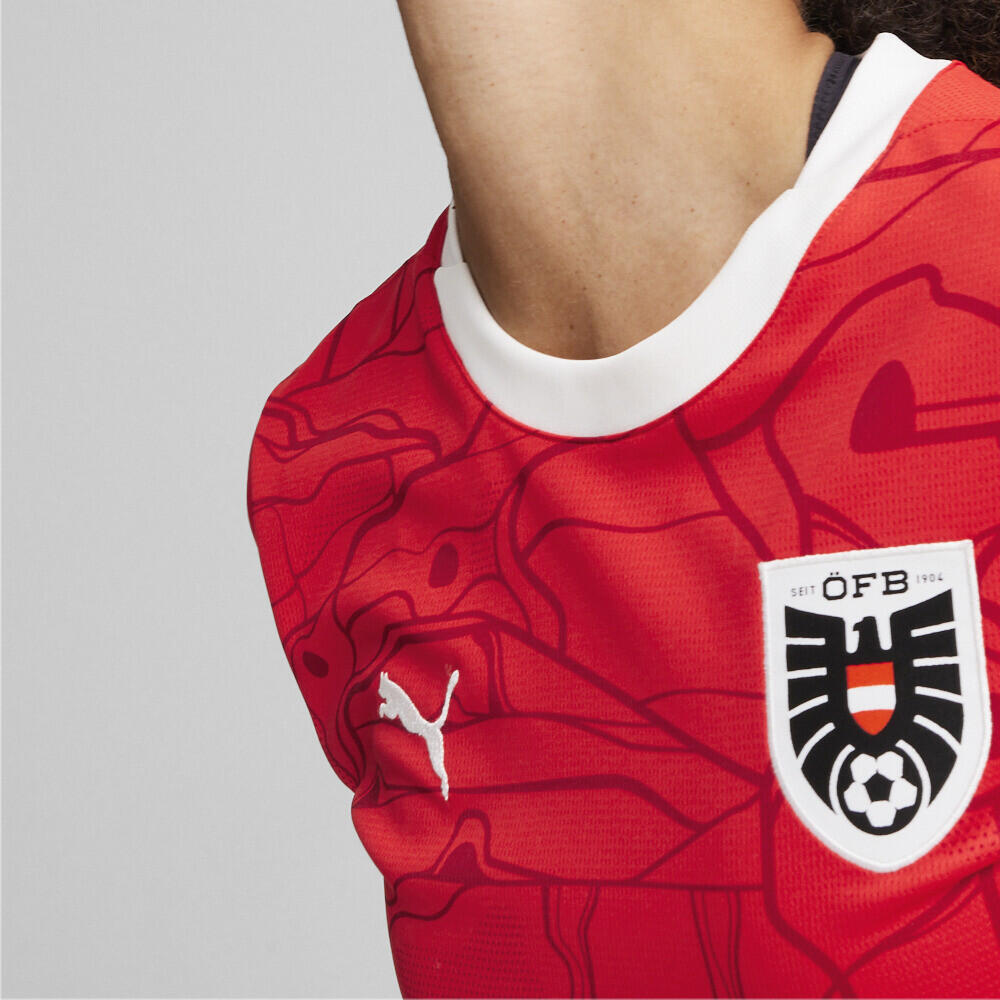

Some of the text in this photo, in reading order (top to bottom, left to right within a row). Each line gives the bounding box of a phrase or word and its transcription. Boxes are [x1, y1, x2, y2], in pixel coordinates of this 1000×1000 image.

[790, 570, 944, 601] SEIT ÖFB 1904
